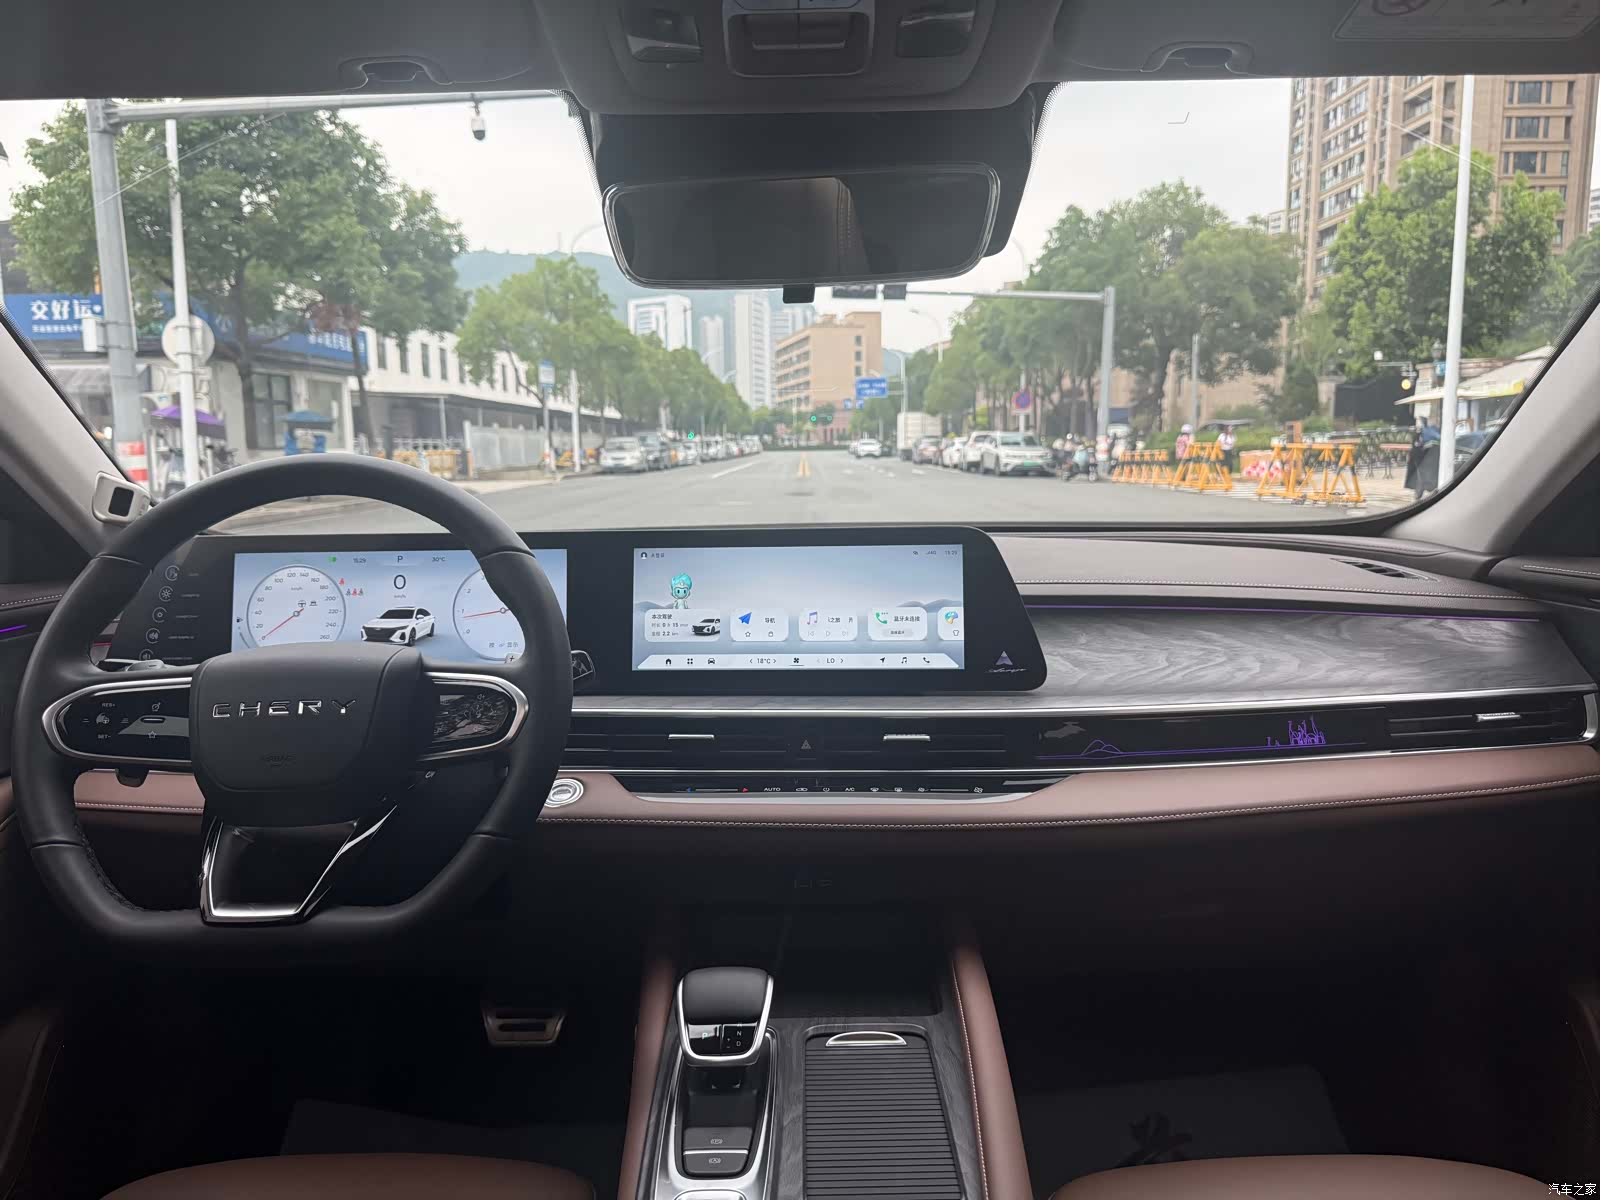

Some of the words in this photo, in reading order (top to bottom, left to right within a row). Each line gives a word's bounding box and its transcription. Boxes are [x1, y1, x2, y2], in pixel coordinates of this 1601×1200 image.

[397, 555, 403, 563] P
[393, 574, 406, 590] 0
[212, 700, 356, 718] CHERY
